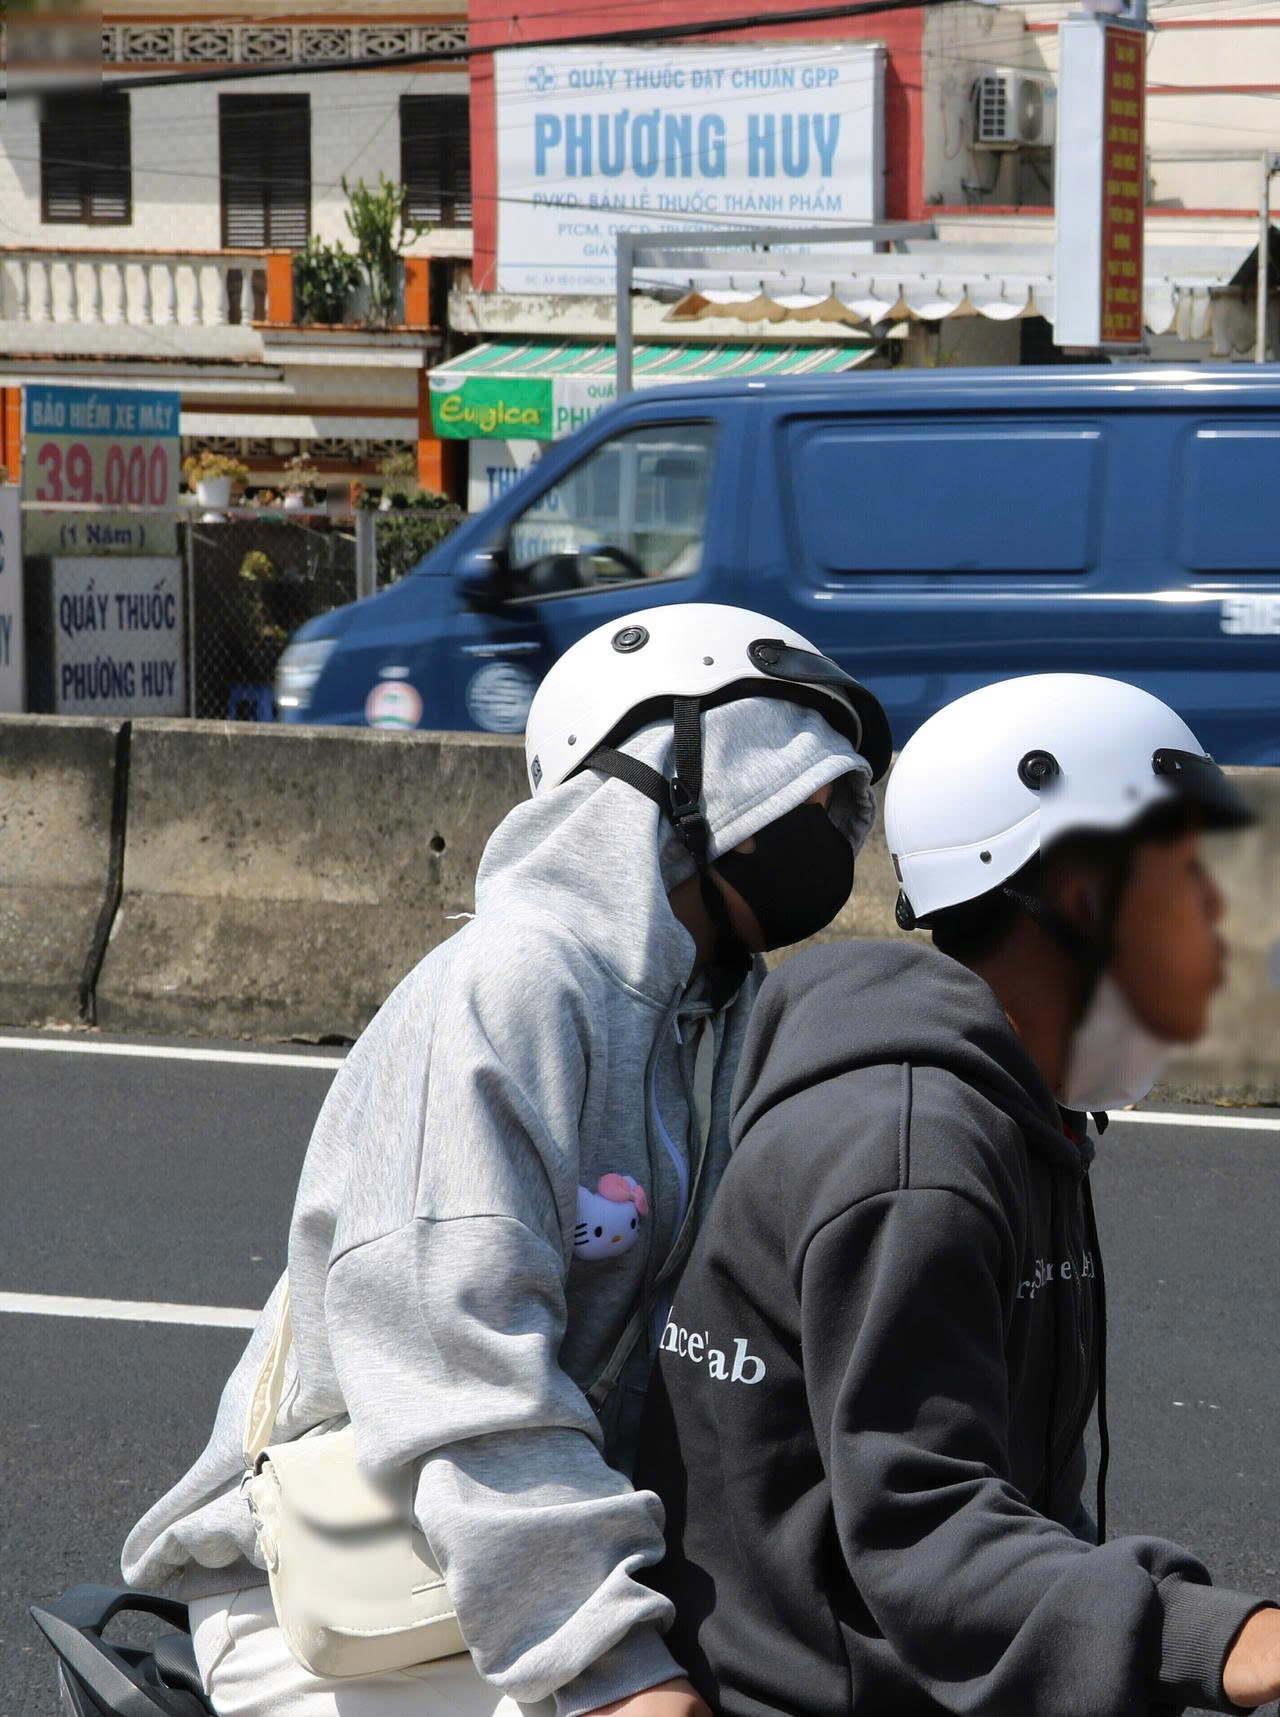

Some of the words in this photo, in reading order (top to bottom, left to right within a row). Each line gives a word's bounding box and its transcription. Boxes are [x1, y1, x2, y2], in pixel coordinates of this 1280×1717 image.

[624, 61, 684, 88] THUỐC
[801, 68, 840, 88] GPP
[533, 108, 727, 178] PHƯƠNG
[747, 112, 841, 178] HUY
[658, 189, 717, 212] THUỐC
[33, 392, 64, 427] BẢO
[115, 403, 135, 430] XE
[139, 400, 174, 430] MÁY
[36, 442, 168, 514] 39.000
[60, 578, 109, 639] QUẦY
[115, 578, 176, 632] THUỐC
[62, 654, 136, 701] PHƯƠNG
[141, 659, 176, 698] HUY
